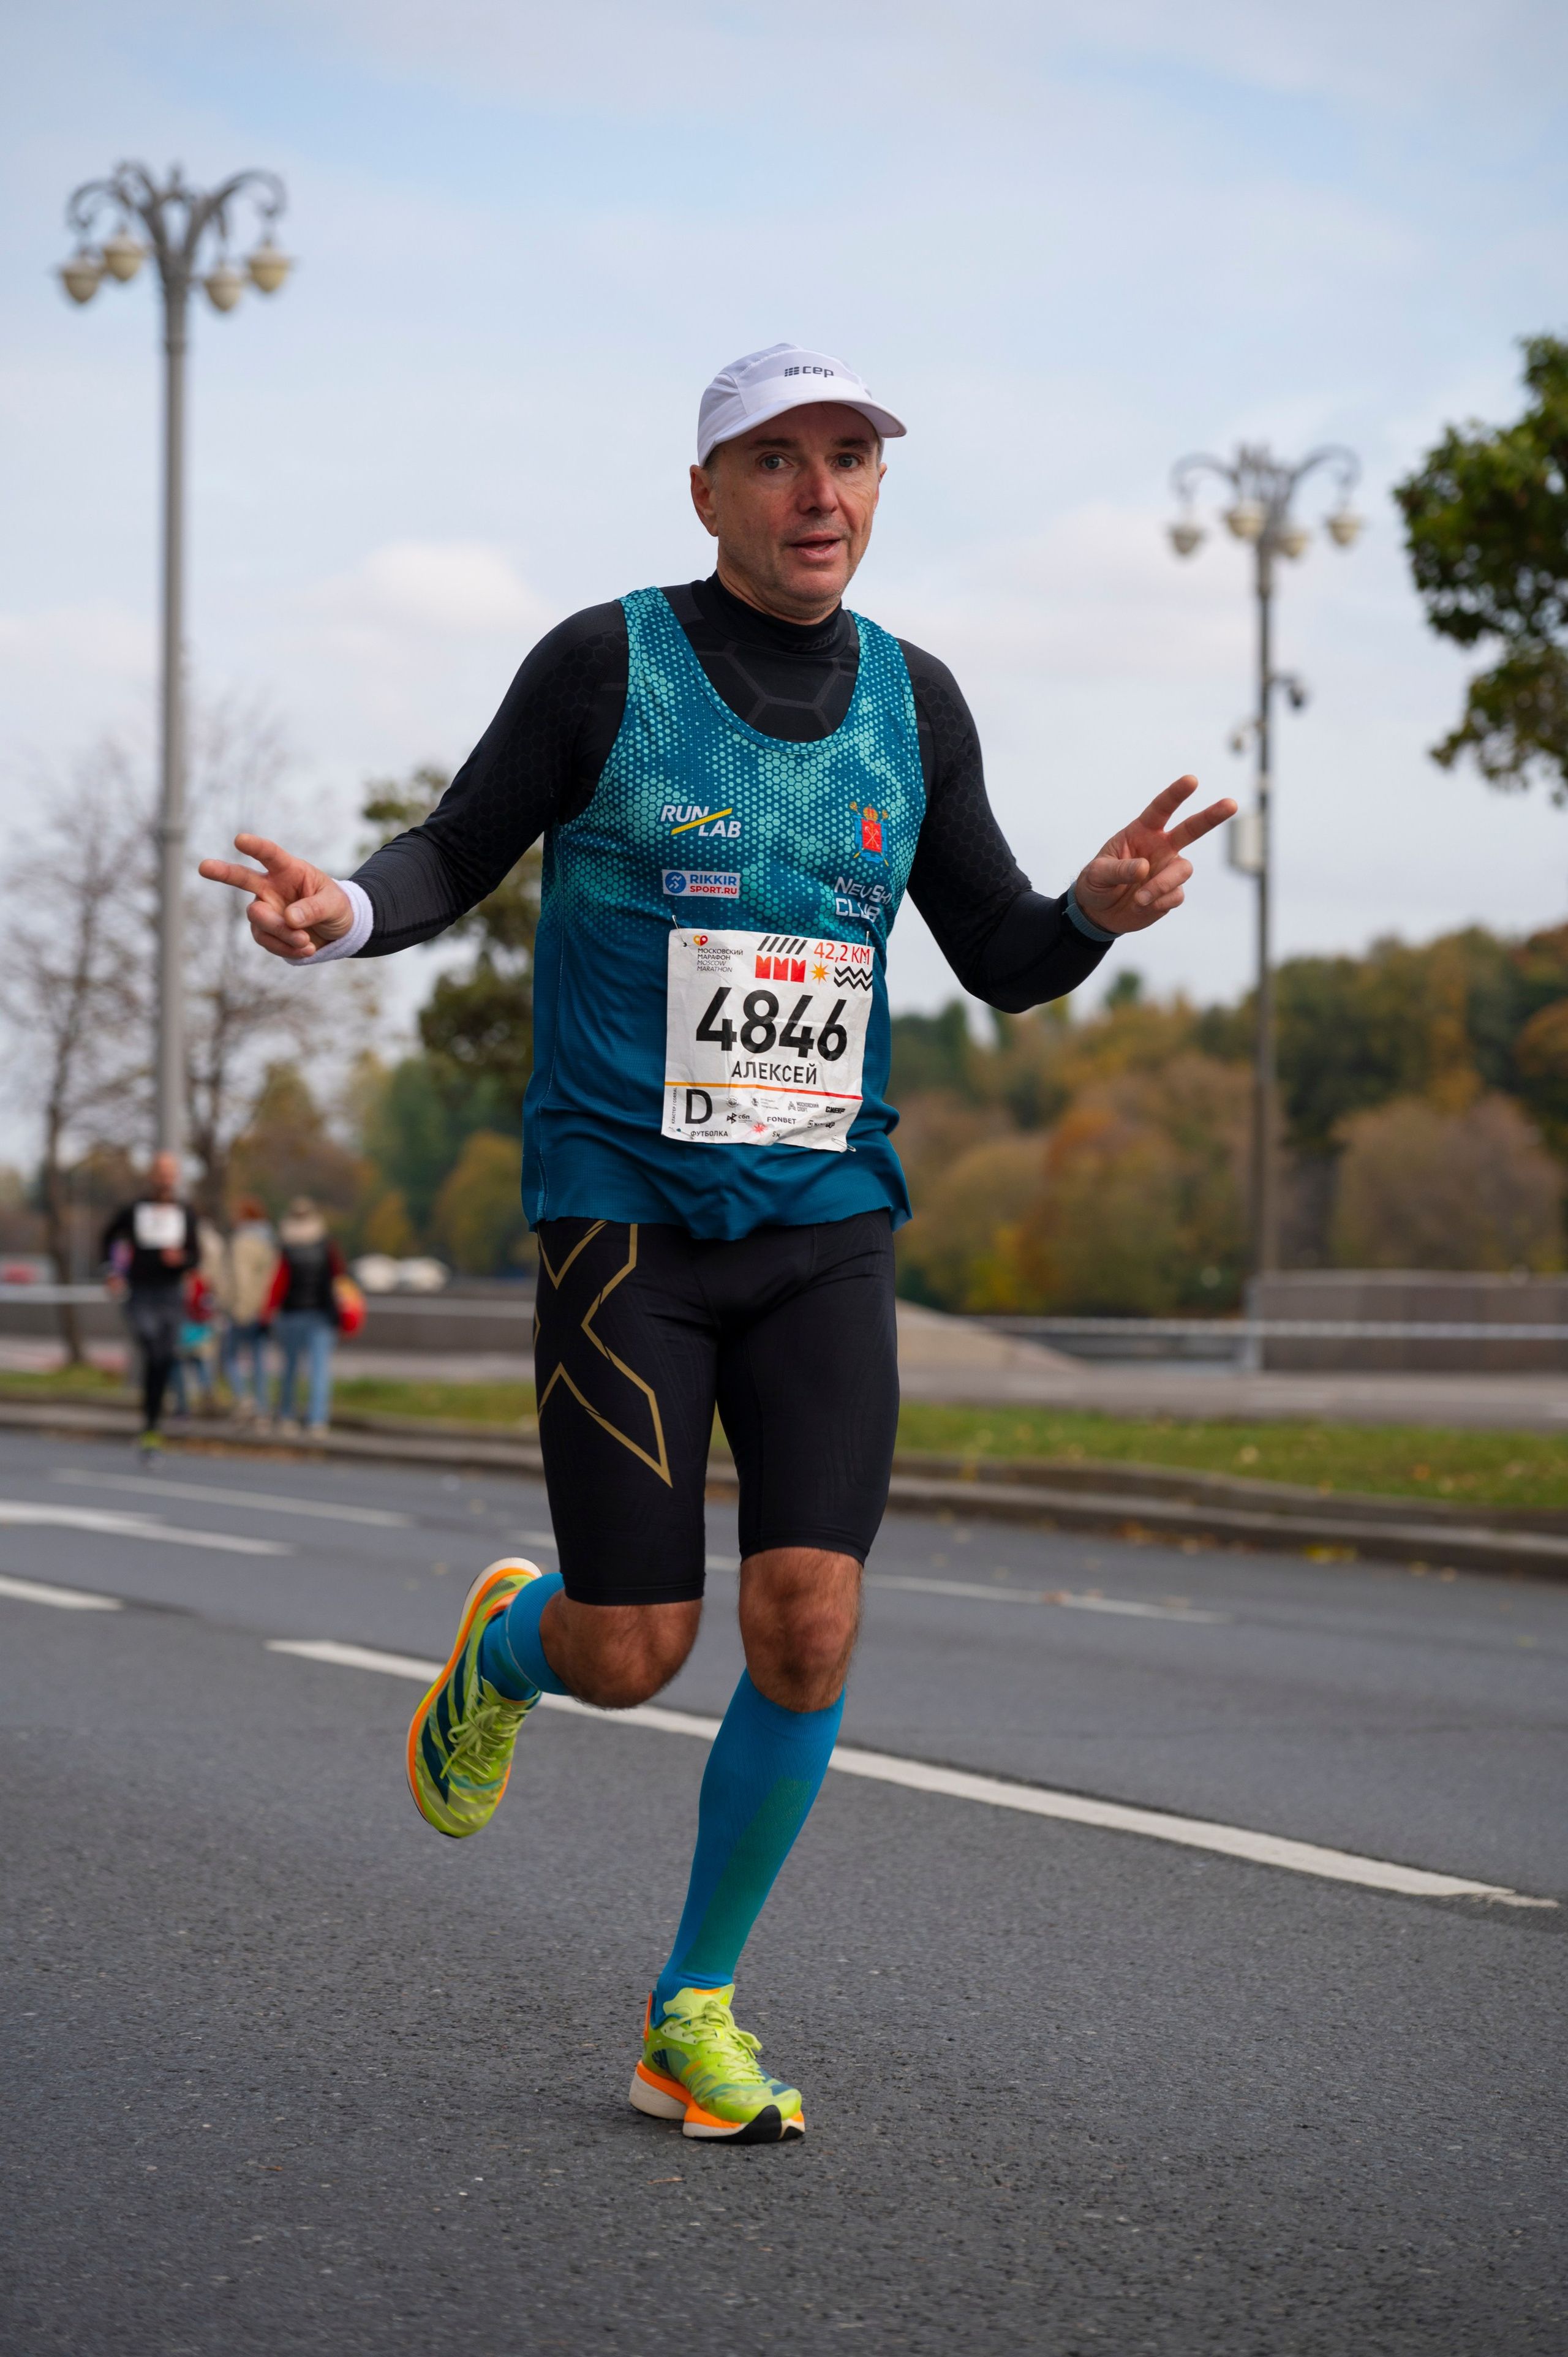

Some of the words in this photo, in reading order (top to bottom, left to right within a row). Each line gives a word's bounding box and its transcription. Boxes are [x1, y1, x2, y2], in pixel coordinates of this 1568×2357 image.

[802, 366, 834, 378] cep
[660, 805, 710, 823] RUN
[698, 820, 742, 838] LAB
[690, 874, 737, 886] RIKKIR
[690, 886, 737, 895] SPORT.RU
[835, 897, 881, 923] CLUB
[813, 942, 848, 962] 42,2
[696, 986, 848, 1062] 4846
[731, 1060, 817, 1085] АЛЕКСЕЙ
[685, 1088, 713, 1125] D
